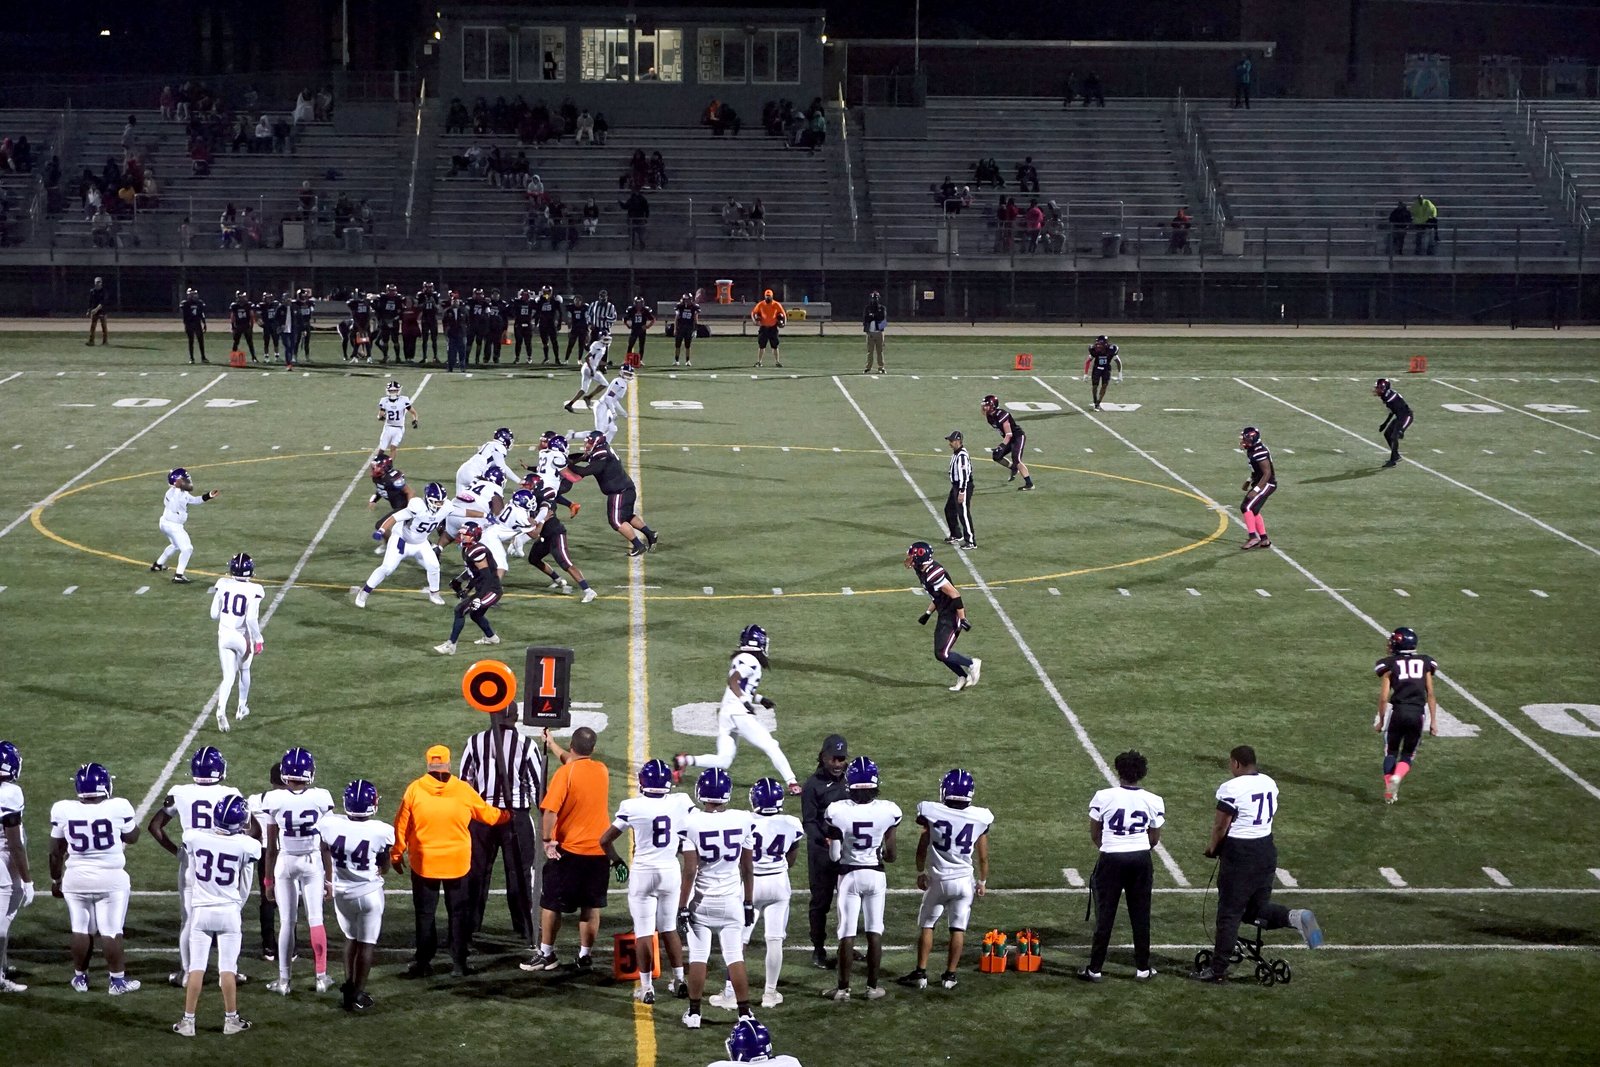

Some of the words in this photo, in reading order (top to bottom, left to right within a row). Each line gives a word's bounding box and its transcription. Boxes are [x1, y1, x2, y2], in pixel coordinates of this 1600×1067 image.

[626, 353, 640, 366] 50
[1018, 354, 1031, 367] 40
[1412, 359, 1425, 370] 30
[387, 410, 400, 421] 21
[416, 522, 439, 533] 50
[221, 591, 247, 617] 10
[539, 656, 557, 697] 1
[1396, 659, 1425, 680] 10
[190, 800, 214, 829] 6
[282, 809, 320, 837] 12
[1108, 808, 1149, 836] 42
[1251, 792, 1273, 825] 71
[67, 818, 116, 852] 58
[652, 815, 671, 848] 8
[699, 828, 743, 863] 55
[852, 821, 873, 850] 5
[932, 819, 975, 854] 34
[194, 848, 239, 886] 35
[330, 834, 370, 871] 44
